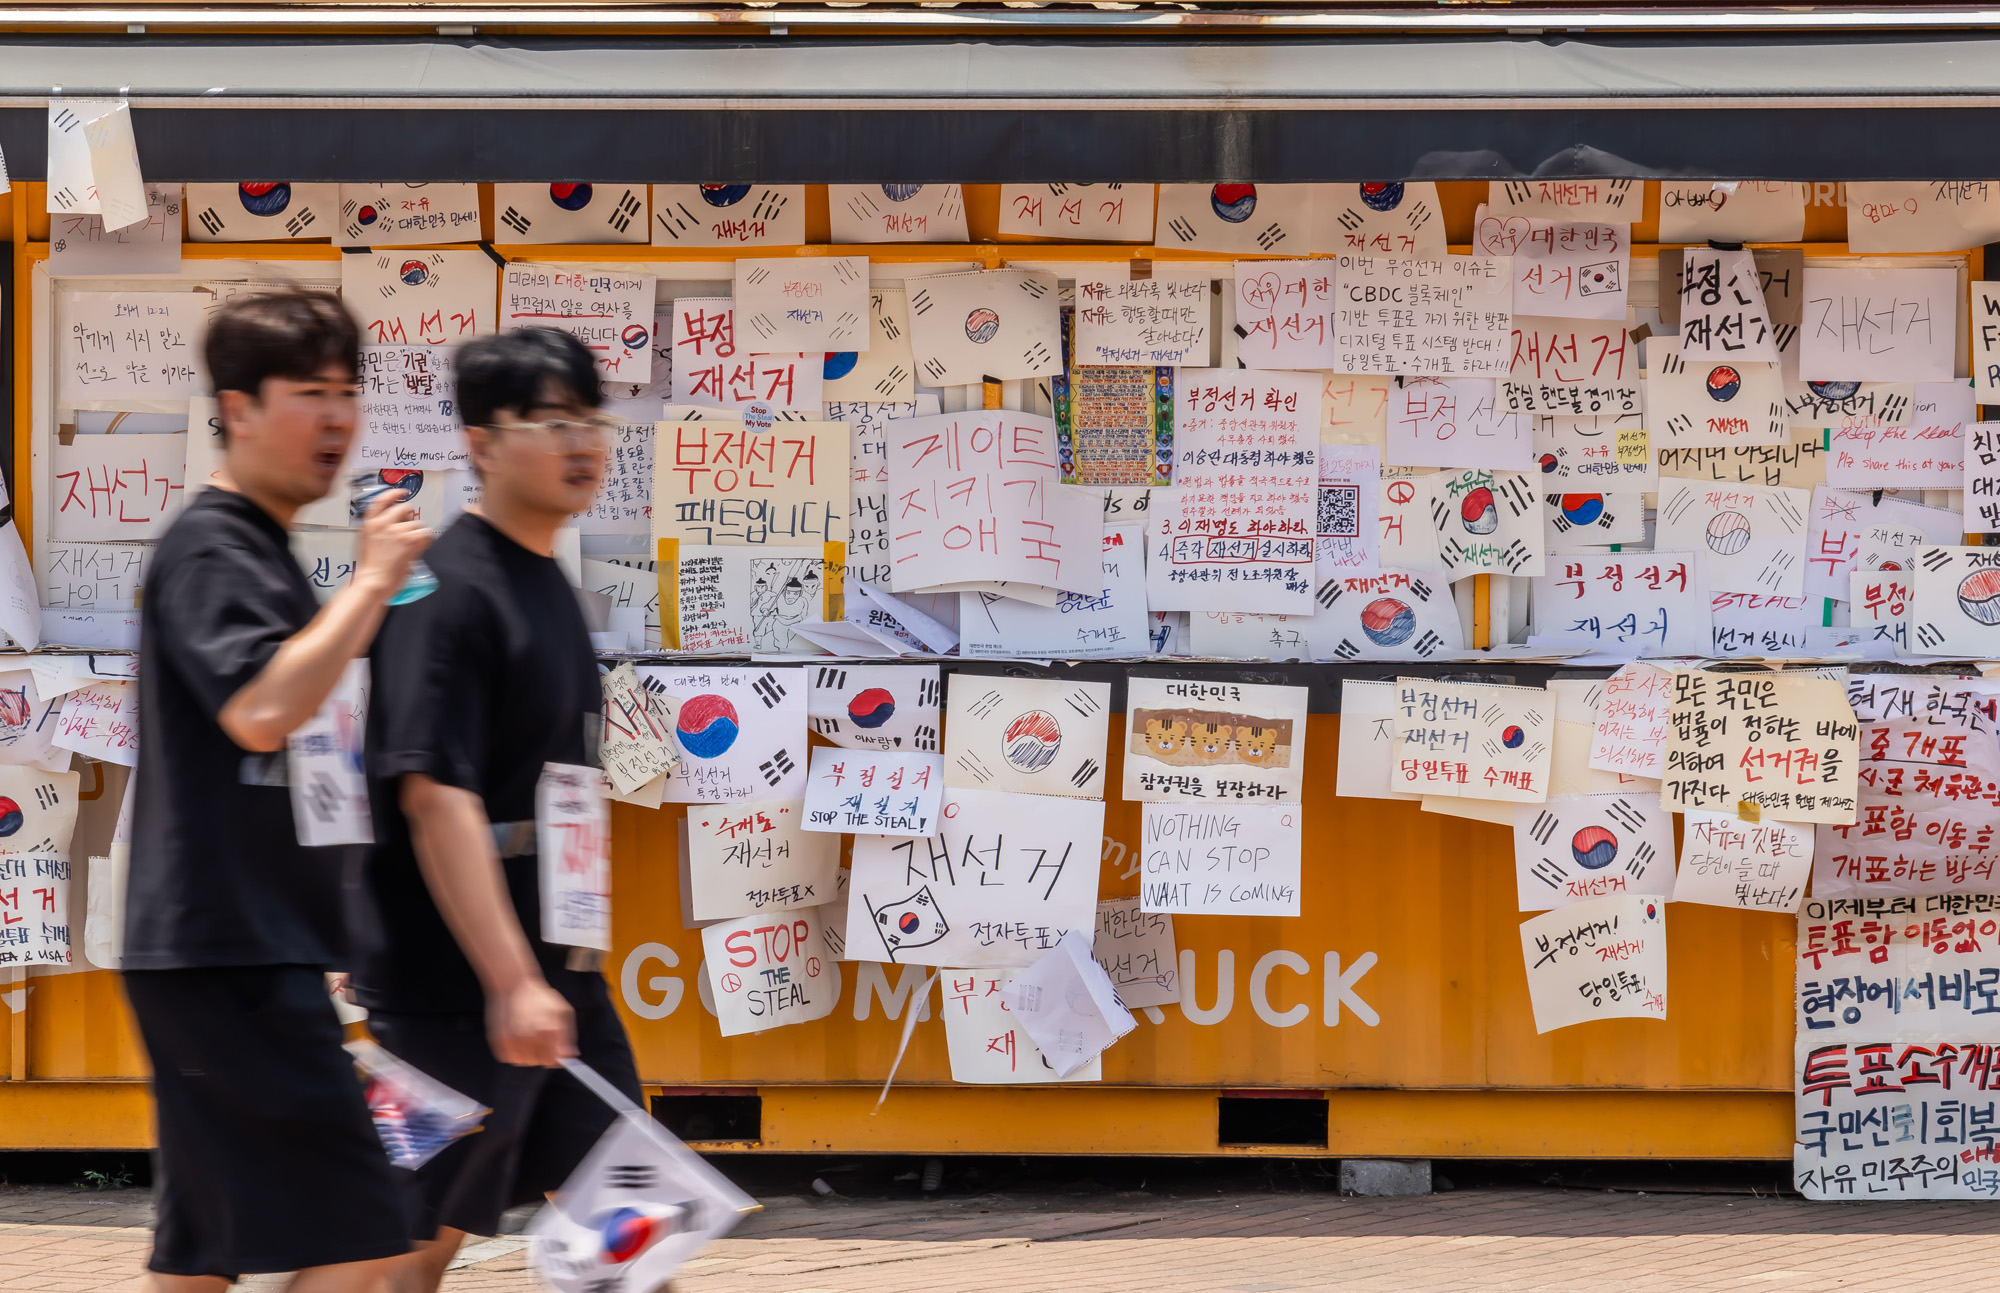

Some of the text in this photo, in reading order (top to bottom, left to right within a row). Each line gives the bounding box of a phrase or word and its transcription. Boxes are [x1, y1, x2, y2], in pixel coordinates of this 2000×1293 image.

[400, 196, 430, 212] 자유
[1539, 182, 1598, 207] 재선거
[398, 211, 478, 231] 대한민국 만세!
[882, 212, 928, 234] 재선거
[1012, 195, 1124, 227] 재선거
[1862, 203, 1900, 223] 엄마
[712, 219, 766, 241] 재선거
[1344, 231, 1416, 254] 재선거
[1531, 226, 1618, 255] 대한민국
[1340, 255, 1497, 278] 이번 이슈는
[508, 271, 550, 288] 미래의
[782, 280, 823, 298] 부정선거
[1080, 281, 1161, 302] 자유는 외칠수록
[147, 305, 170, 317] 12:21
[510, 293, 633, 320] 부끄럽지 않은 역사를
[787, 309, 824, 325] 재선거
[1081, 305, 1117, 326] 자유는
[368, 308, 477, 345] 재선거
[1249, 312, 1325, 350] 재선거
[1341, 309, 1510, 331] 기반 투표로 가기 위한 발판
[1809, 296, 1932, 355] 재선거
[73, 321, 187, 354] 악에게 지지 말고
[1340, 333, 1386, 351] 디지털
[1392, 333, 1417, 351] 투표
[1422, 335, 1458, 352] 시스템
[1342, 353, 1400, 372] 당일투표
[1411, 355, 1455, 373] 수개표
[1510, 328, 1627, 382] 재선거
[76, 361, 196, 385] 선으로 악을 이기라
[688, 360, 794, 406] 재선거
[1187, 386, 1255, 412] 부정선거
[1264, 387, 1298, 412] 확인
[1502, 381, 1636, 414] 잠실 핸드볼 경기장
[751, 406, 767, 415] Stop
[828, 399, 918, 423] 부정선거
[745, 420, 772, 428] My Vote
[1618, 431, 1647, 442] 재선거
[362, 446, 446, 462] Every Vote must
[673, 427, 816, 494] 부정선거
[1182, 448, 1261, 467] 이승만 대통령
[1583, 445, 1610, 458] 자유
[1863, 457, 1890, 471] share
[1895, 457, 1918, 471] this
[1922, 459, 1934, 470] at
[56, 458, 186, 523] 재선거
[900, 474, 1044, 520] 지키기
[1704, 491, 1755, 510] 재선거
[675, 499, 841, 545] 팩트입니다
[1178, 518, 1239, 536] 이재명도
[943, 517, 1062, 580] 애국
[1175, 540, 1255, 560] 즉각 재선거
[1871, 528, 1922, 547] 재선거
[1462, 543, 1505, 567] 재선거
[1344, 573, 1410, 594] 재선거
[1554, 562, 1688, 600] 부정선거
[1076, 625, 1127, 643] 수개표
[1564, 607, 1668, 649] 재선거
[1166, 684, 1241, 702] 대한민국
[1675, 673, 1707, 706] 모든
[1716, 678, 1779, 710] 국민은
[1400, 688, 1478, 722] 부정선거
[1402, 727, 1470, 754] 재선거
[1672, 710, 1857, 748] 법률이 정하는 바에
[1903, 731, 1968, 767] 개표
[1401, 758, 1539, 793] 당일투표 수개표
[1667, 745, 1843, 785] 의하여 선거권을
[1140, 773, 1288, 800] 참정권을 보장하라
[1742, 790, 1791, 809] 대한민국
[809, 810, 927, 833] STOP THE STEAL!
[1147, 813, 1242, 844] NOTHING
[1691, 819, 1804, 858] 자유의 깃발은
[1926, 818, 1995, 855] 이동 후
[722, 838, 790, 869] 재선거
[1147, 846, 1271, 874] CAN STOP
[892, 832, 1073, 901] 재선거
[1690, 853, 1780, 881] 당신이 때
[1832, 853, 1994, 884] 개표하는 방식
[1203, 883, 1294, 905] IS COMING
[1565, 875, 1627, 897] 재선거
[1806, 896, 1916, 921] 이제부터
[38, 949, 65, 963] USA
[724, 919, 809, 968] STOP
[1802, 918, 1898, 971] 투표함
[759, 966, 791, 987] THE
[747, 983, 811, 1018] STEAL
[1801, 967, 2000, 1030] 현장에서 바로
[1801, 1100, 2000, 1158] 국민신뢰 회복
[1799, 1153, 1959, 1195] 자유 민주주의
